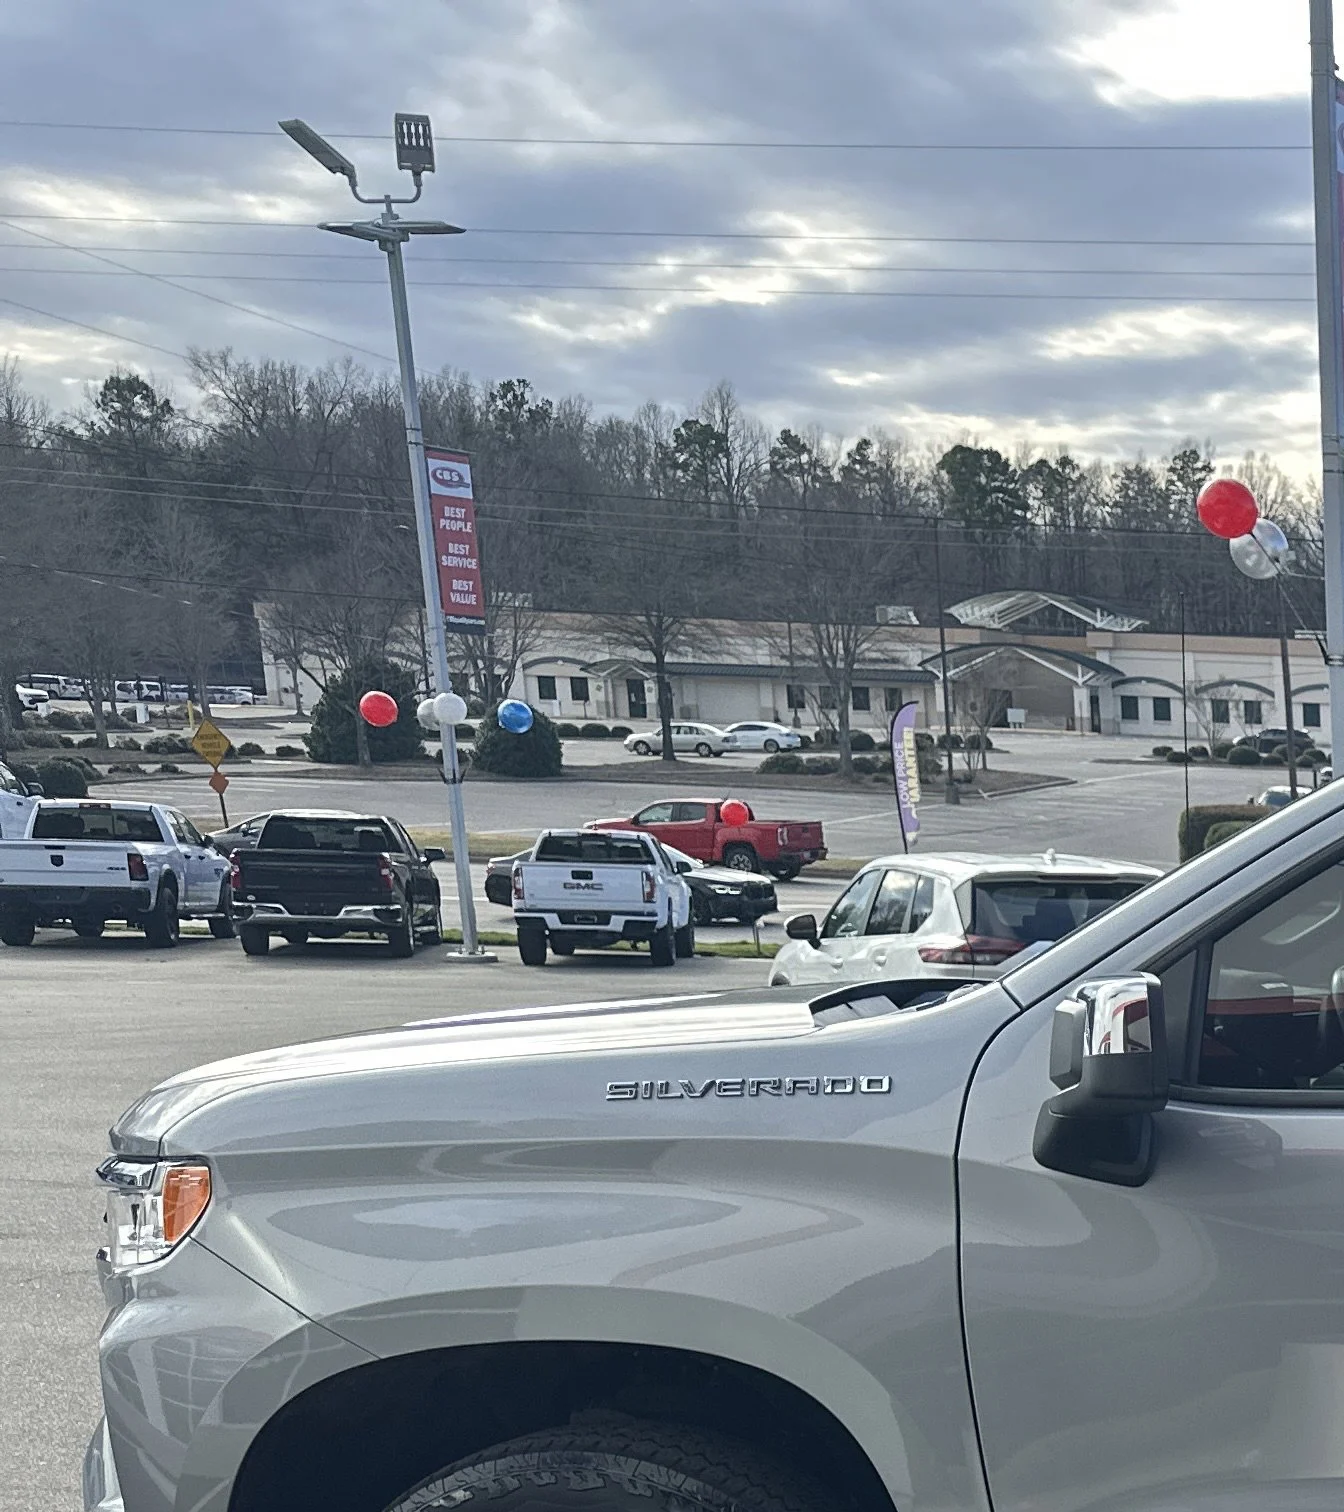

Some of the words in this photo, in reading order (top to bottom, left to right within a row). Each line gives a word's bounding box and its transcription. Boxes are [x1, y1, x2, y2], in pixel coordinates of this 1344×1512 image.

[436, 469, 460, 482] CBS
[444, 506, 466, 519] BEST
[440, 518, 472, 533] PEOPLE
[448, 542, 470, 555] BEST
[441, 555, 477, 569] SERVICE
[452, 579, 473, 591] BEST
[450, 591, 477, 605] VALUE
[895, 742, 906, 777] PRICE
[563, 882, 604, 890] GMC
[605, 1075, 892, 1101] SILVERADO
